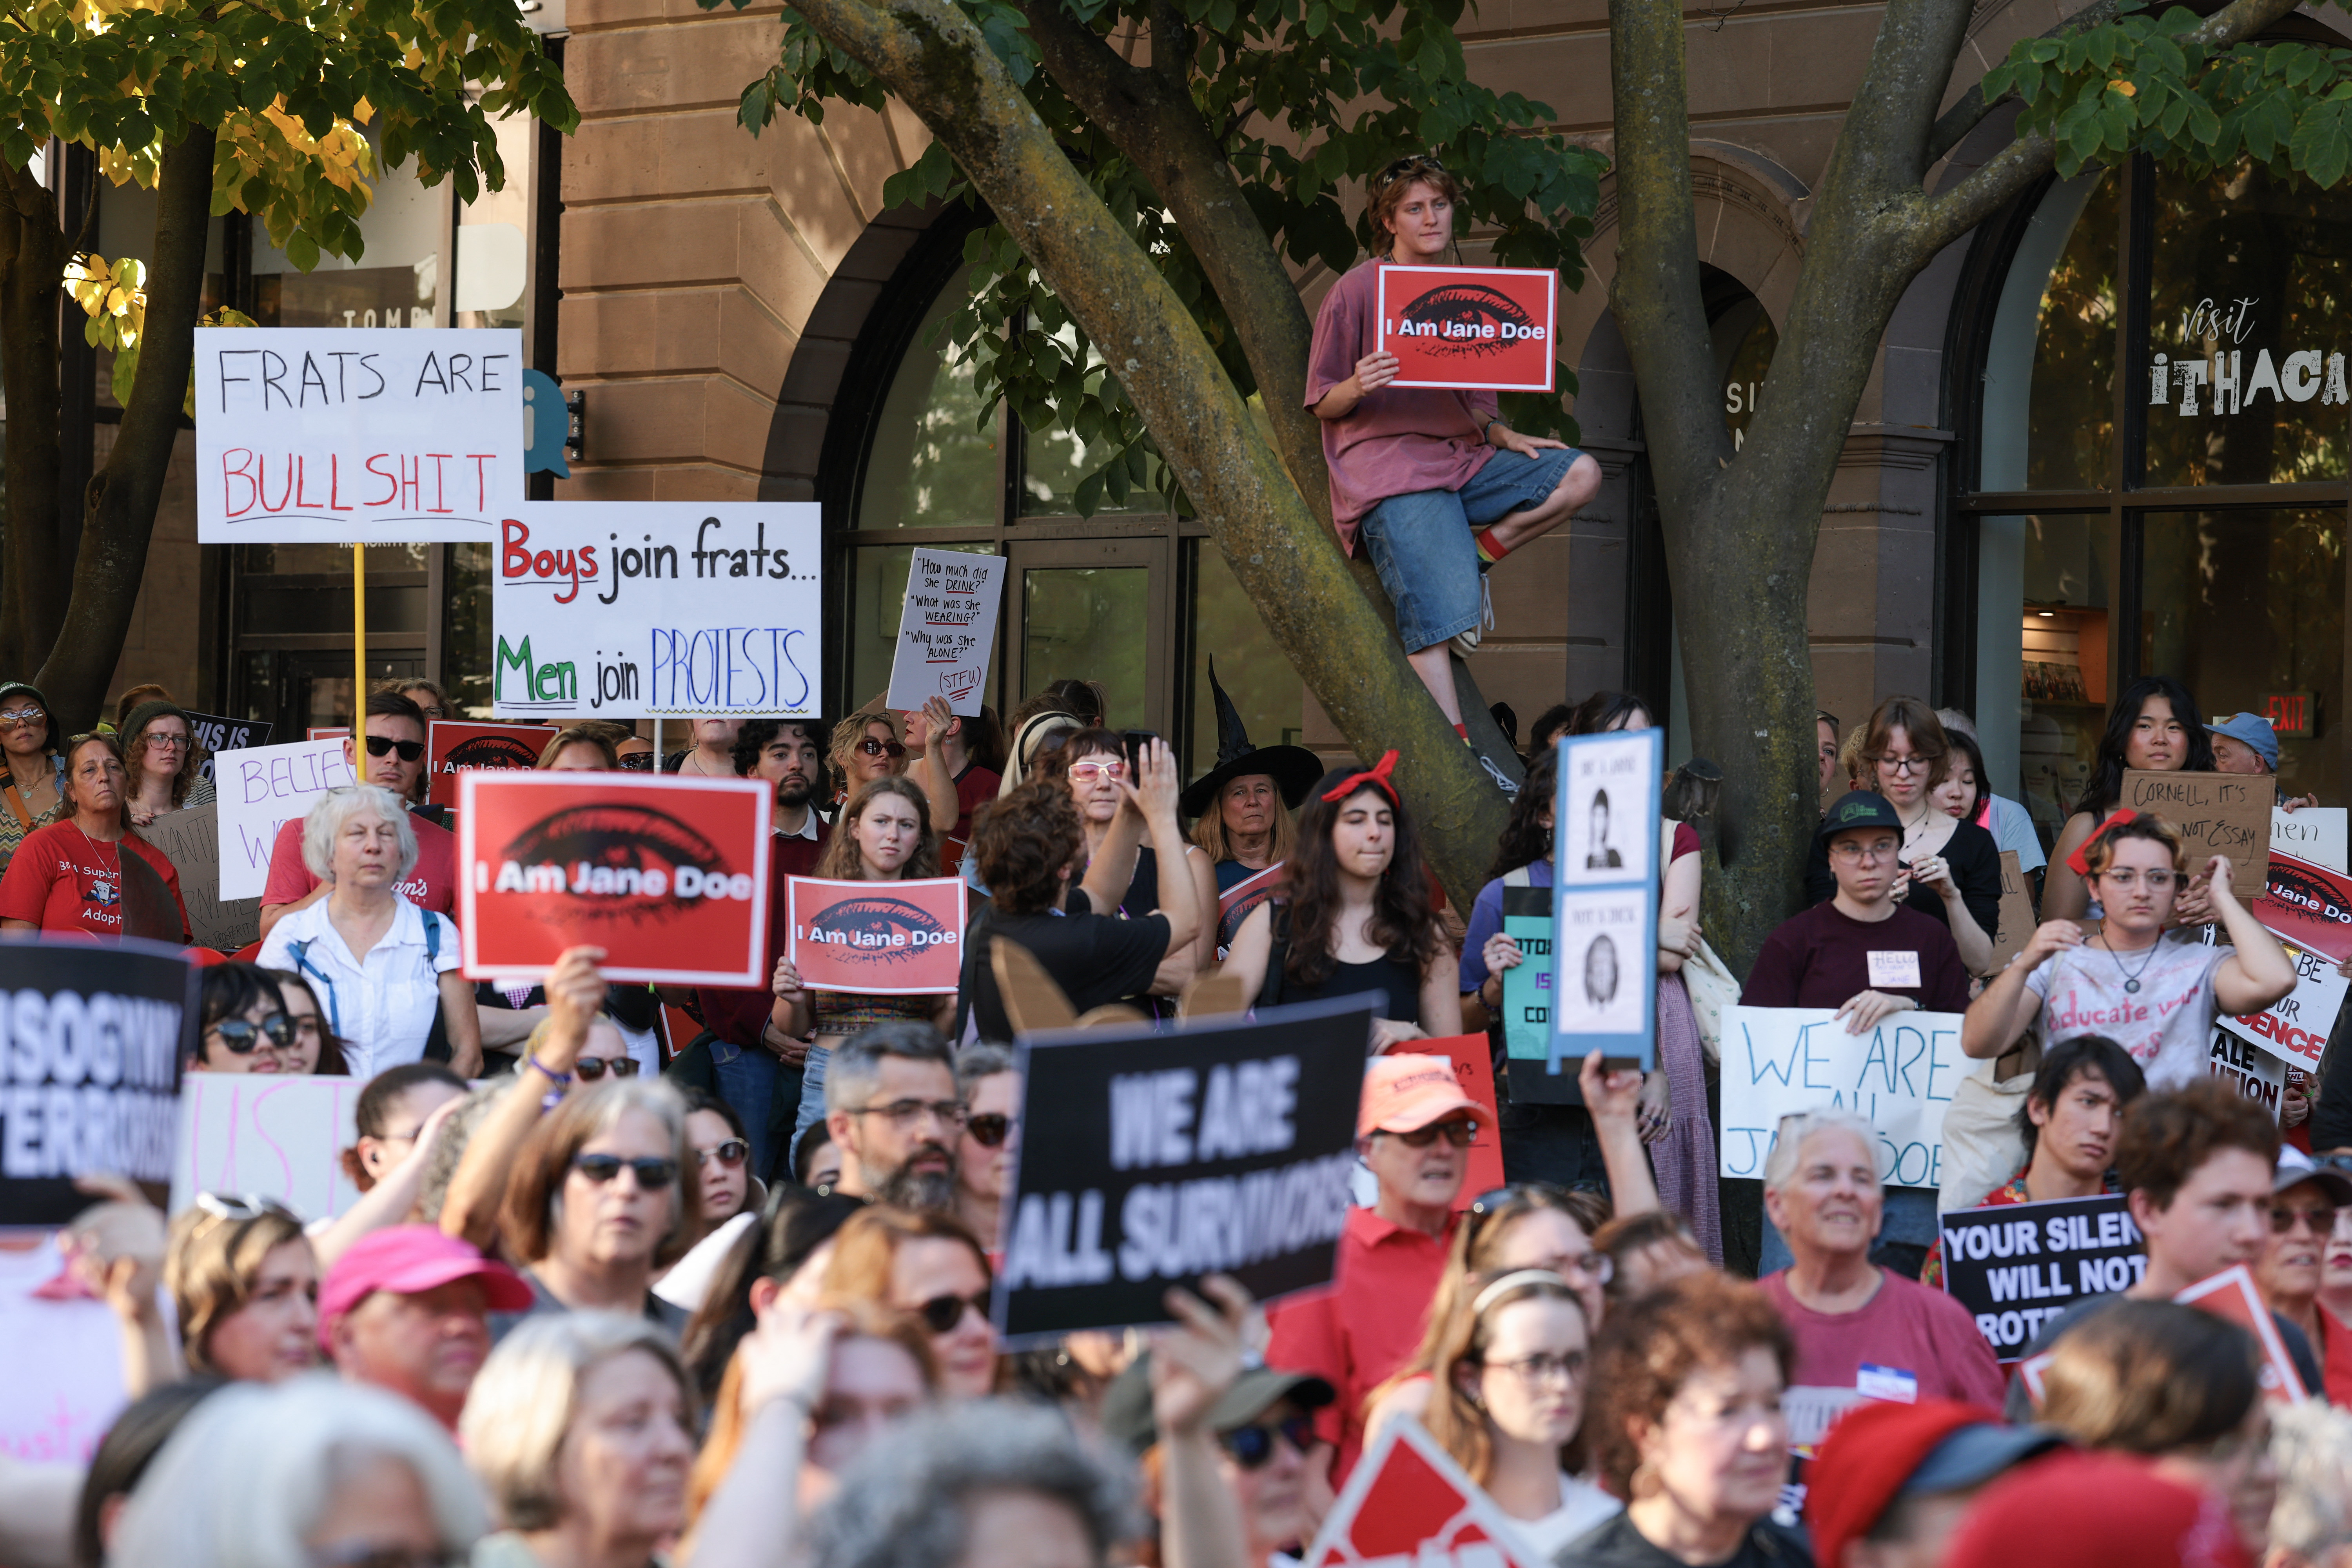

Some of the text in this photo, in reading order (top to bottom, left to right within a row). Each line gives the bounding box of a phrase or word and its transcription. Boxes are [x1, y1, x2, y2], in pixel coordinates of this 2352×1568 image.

[343, 306, 436, 328] TOMP
[1386, 318, 1546, 340] I Am Jane Doe
[219, 350, 509, 414] FRATS ARE
[222, 448, 496, 517] BULLSHIT
[502, 517, 817, 604] Boys join frats...
[946, 564, 968, 577] much
[973, 568, 988, 580] did
[924, 577, 939, 588] she
[926, 611, 980, 624] WEARING?"
[943, 599, 960, 610] was
[965, 599, 980, 610] she
[936, 634, 953, 645] was
[957, 635, 976, 647] she
[495, 628, 809, 708] Men join PROTESTS
[939, 666, 981, 693] (STFU)
[2269, 696, 2306, 731] EXIT
[192, 720, 250, 752] HIS IS
[433, 761, 438, 773] I
[443, 761, 474, 774] Am
[2134, 779, 2246, 807] CORNELL, IT'S
[2182, 820, 2256, 866] NOT ESSAY
[59, 861, 70, 870] Be
[83, 866, 121, 879] Super
[476, 861, 753, 900] I Am Jane Doe
[82, 908, 122, 926] Adopt
[2273, 884, 2352, 924] Jane Do
[797, 925, 957, 946] I Am Jane Doe
[2296, 953, 2327, 984] BE
[1742, 1022, 1956, 1101] WE ARE
[2210, 1033, 2256, 1072] ALE
[1109, 1054, 1301, 1171] WE ARE
[1004, 1187, 1114, 1290] ALL
[1944, 1211, 2143, 1262] YOUR SILEN
[1986, 1254, 2148, 1303] WILL NOT
